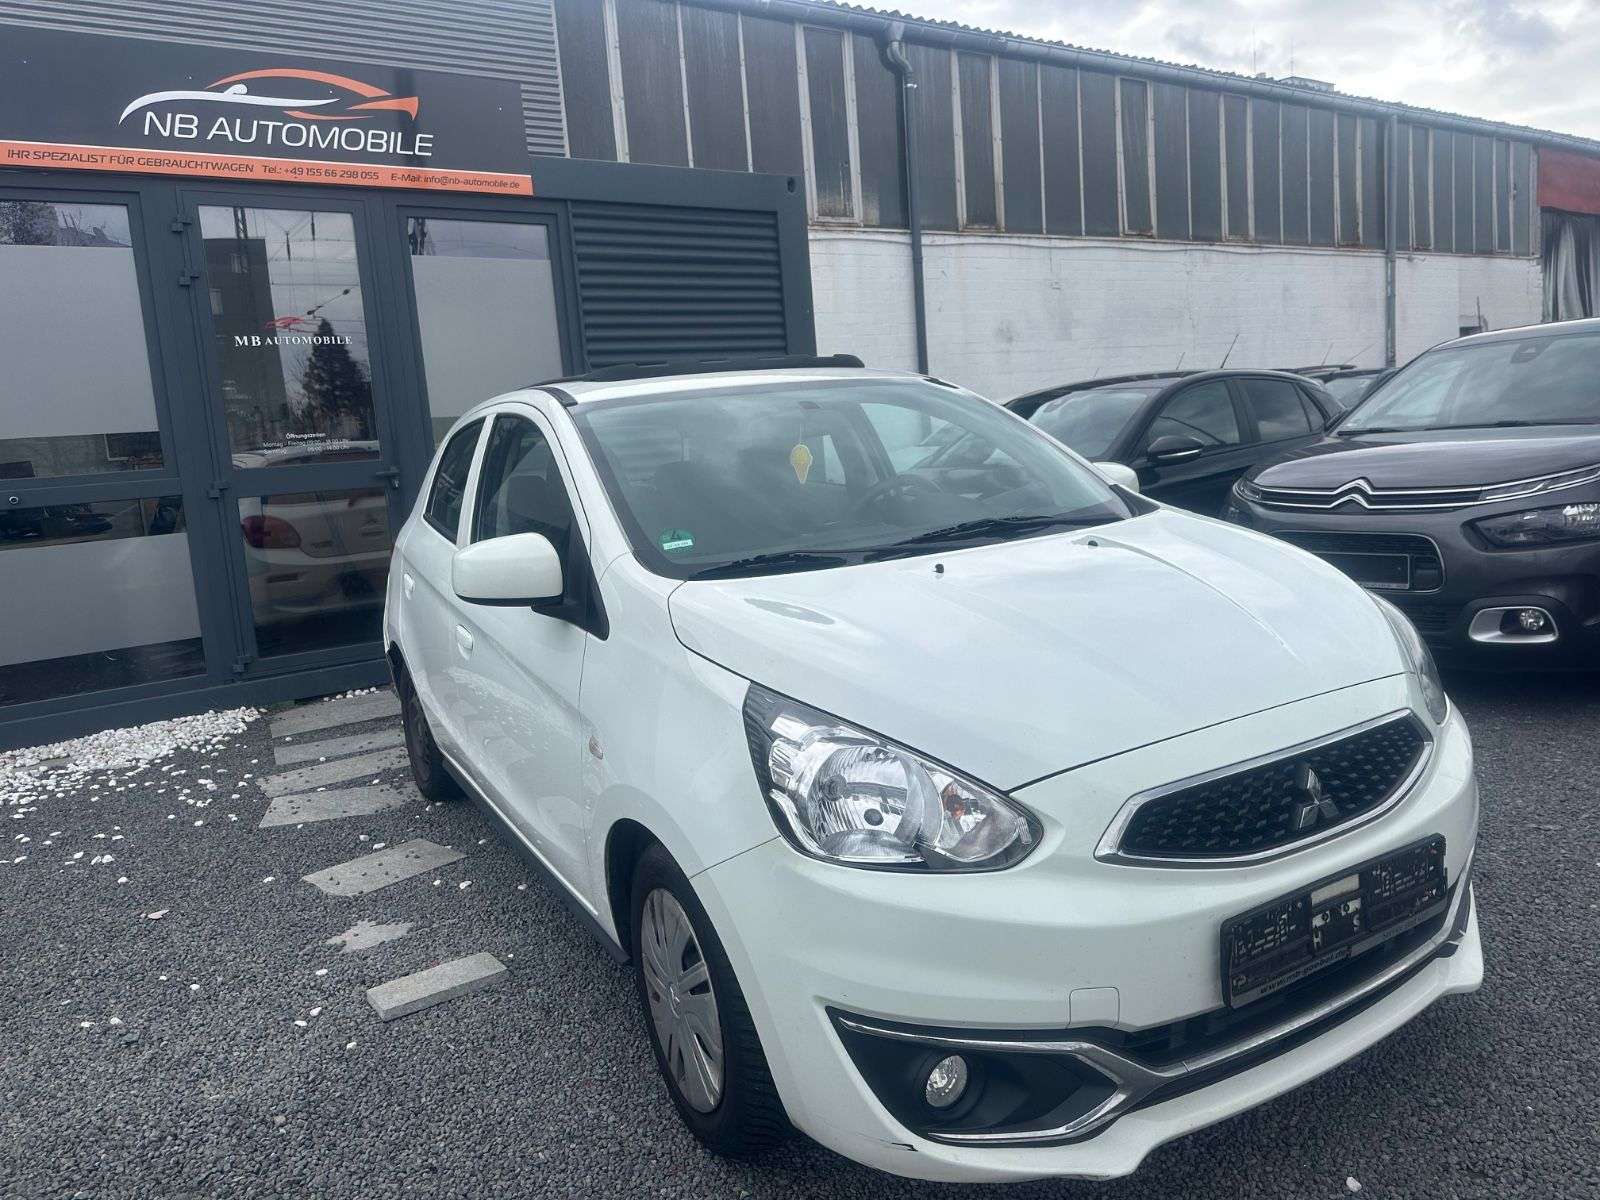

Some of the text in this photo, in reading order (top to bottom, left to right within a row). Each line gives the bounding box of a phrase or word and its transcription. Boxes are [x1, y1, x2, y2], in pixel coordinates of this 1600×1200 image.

[144, 111, 434, 156] NB AUTOMOBILE
[7, 149, 520, 189] IHR SPEZIALIST FÜR GEBRAUCHTWAGEN Tel.: +49 155 66 298 055 E-Mail: info@nb-automobile.de
[234, 335, 353, 347] MB AUTOMOBILE
